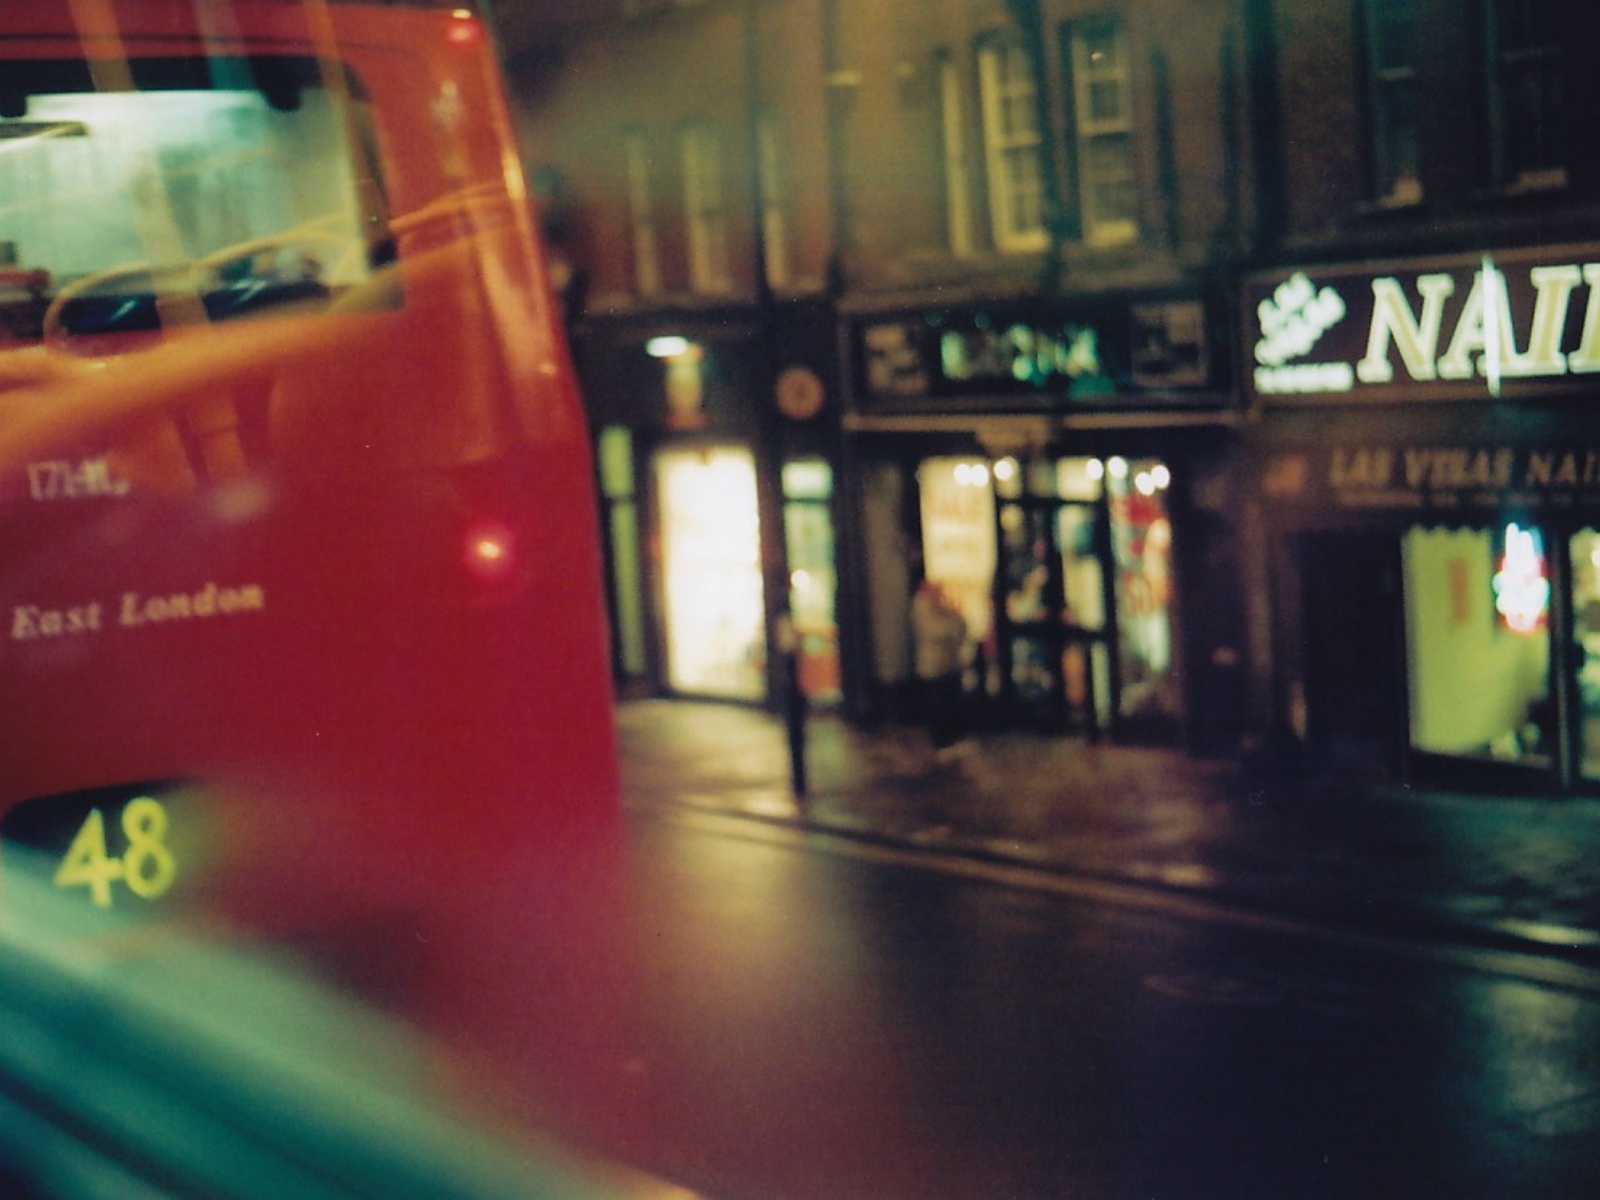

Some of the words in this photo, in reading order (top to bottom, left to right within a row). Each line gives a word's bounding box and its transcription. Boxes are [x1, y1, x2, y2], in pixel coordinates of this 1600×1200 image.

[1525, 451, 1600, 485] NAI
[11, 602, 102, 640] East
[119, 582, 265, 627] London
[53, 796, 175, 910] 48
